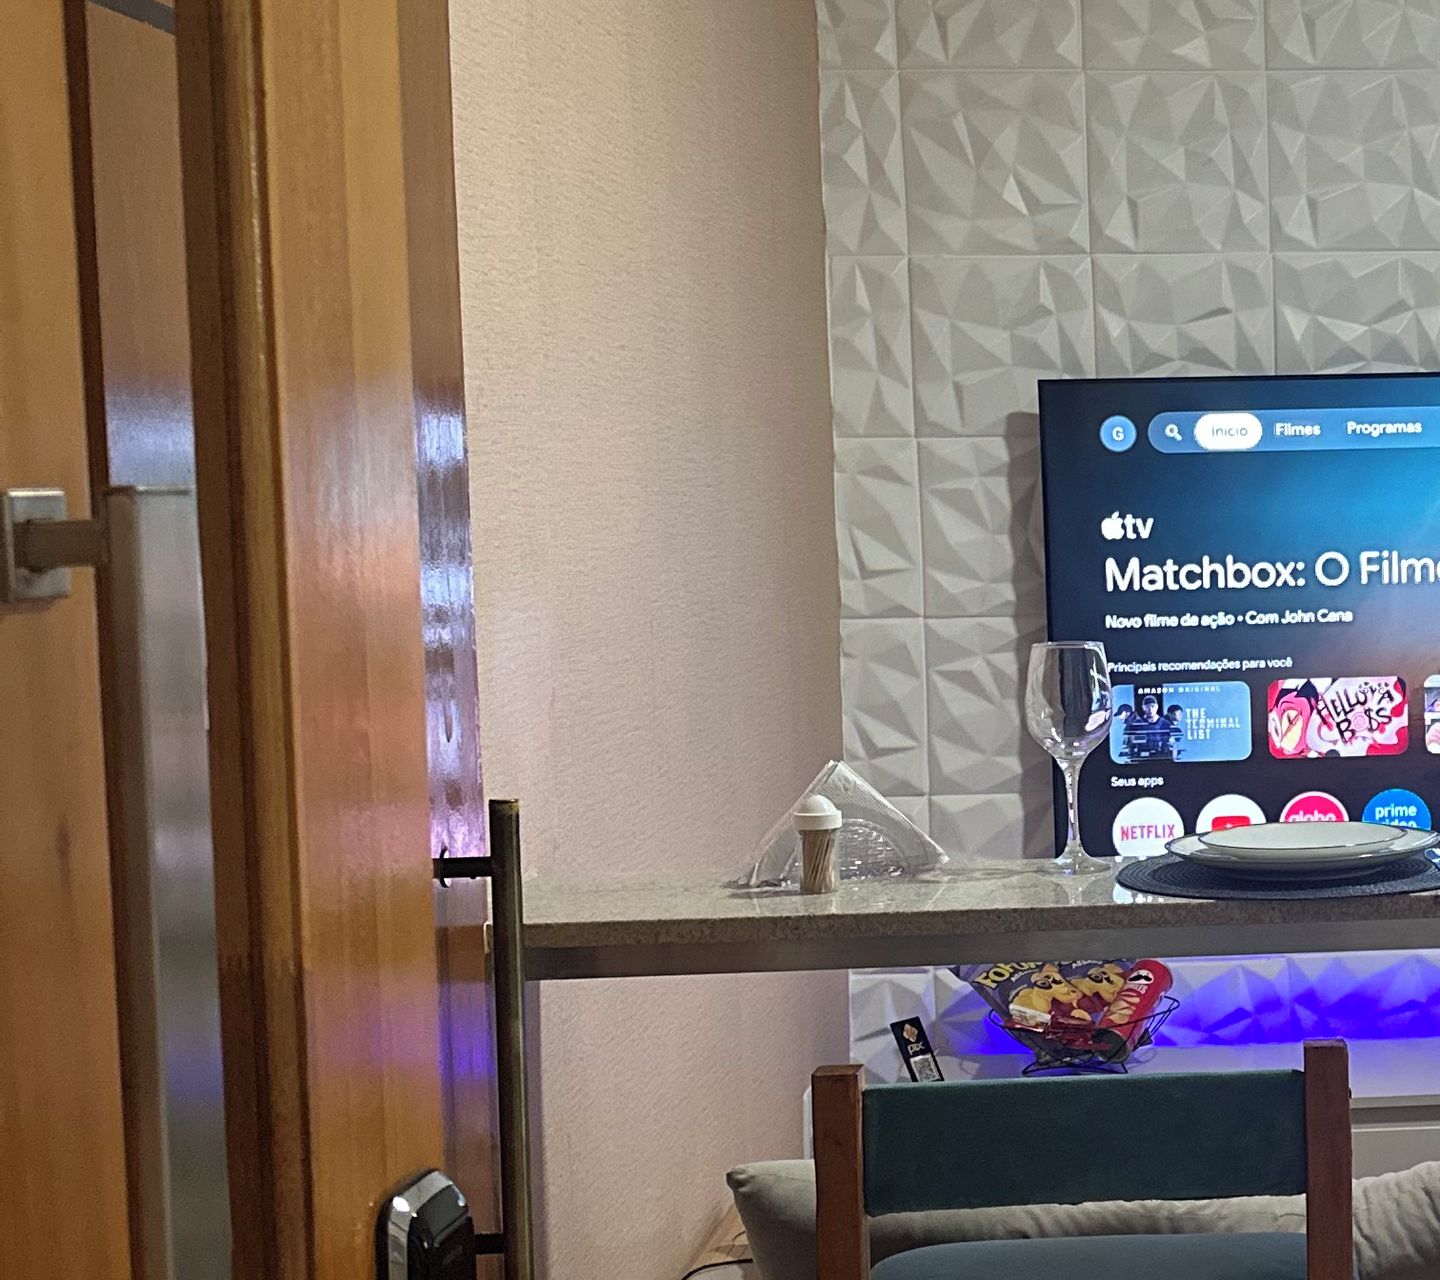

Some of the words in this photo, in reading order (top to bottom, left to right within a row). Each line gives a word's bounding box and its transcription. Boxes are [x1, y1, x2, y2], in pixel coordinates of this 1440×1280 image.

[1275, 422, 1321, 437] Filmes
[1347, 420, 1423, 438] Programas
[1105, 554, 1306, 592] Matchbox:
[1314, 551, 1350, 587] O
[1105, 614, 1142, 629] Novo
[1143, 613, 1179, 628] filme
[1200, 611, 1235, 629] ação
[1245, 610, 1279, 625] Com
[1281, 609, 1315, 624] John
[1316, 608, 1354, 623] Cena
[1107, 660, 1157, 674] Principais
[1157, 658, 1241, 673] recomendações
[1242, 659, 1266, 671] para
[1267, 656, 1293, 669] você
[1178, 685, 1221, 693] ORIGINAL
[1185, 707, 1207, 719] THE
[1185, 717, 1241, 730] TERMINAL
[1187, 728, 1212, 740] LIST
[1110, 776, 1137, 788] Seus
[1137, 776, 1164, 788] apps
[1375, 803, 1418, 821] prime
[1120, 824, 1176, 841] NETFLIX
